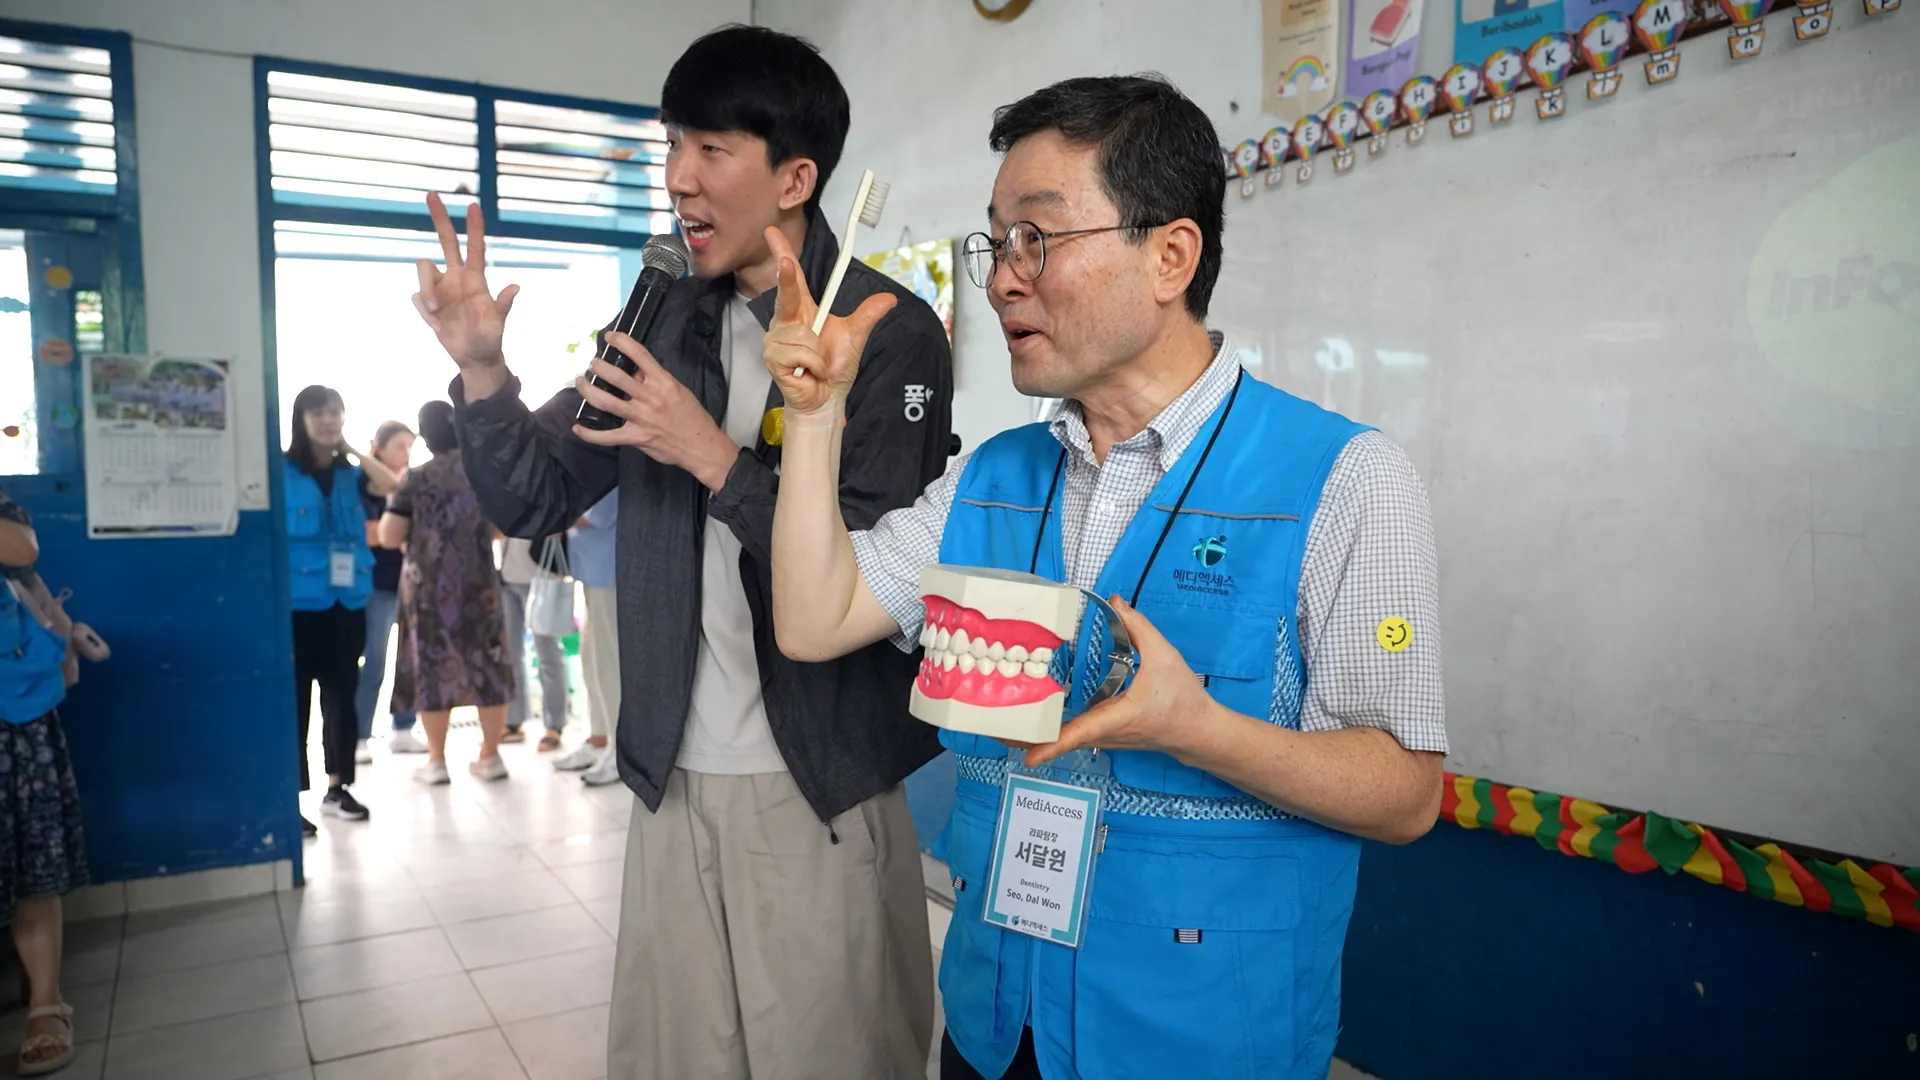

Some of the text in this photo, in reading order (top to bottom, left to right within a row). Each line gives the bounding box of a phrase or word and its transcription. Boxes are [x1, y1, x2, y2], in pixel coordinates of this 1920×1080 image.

[1656, 63, 1670, 75] m
[1744, 38, 1754, 50] n
[1810, 18, 1820, 30] o
[1272, 137, 1281, 150] D
[1305, 127, 1313, 142] E
[1339, 114, 1347, 128] F
[1375, 101, 1385, 115] G
[1413, 89, 1425, 103] H
[1458, 75, 1466, 90] I
[1499, 60, 1509, 77] J
[1545, 48, 1557, 66] K
[1600, 29, 1612, 46] L
[1653, 6, 1672, 27] M
[1173, 569, 1235, 588] 메디엑세스
[1016, 795, 1083, 820] MediAccess
[1015, 841, 1066, 873] 서달원
[1020, 878, 1050, 893] Dentistry
[1006, 888, 1061, 911] Seo, Dal Won
